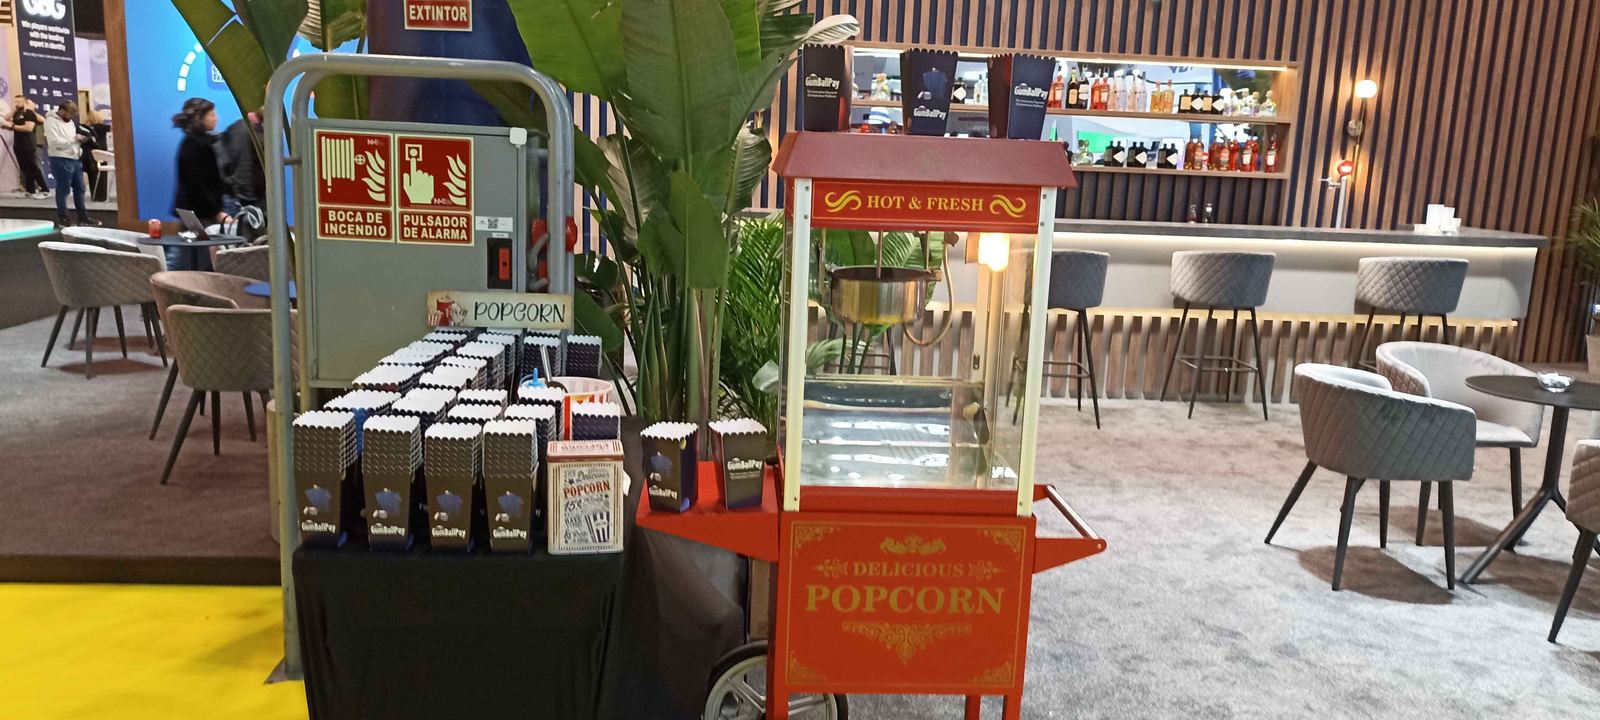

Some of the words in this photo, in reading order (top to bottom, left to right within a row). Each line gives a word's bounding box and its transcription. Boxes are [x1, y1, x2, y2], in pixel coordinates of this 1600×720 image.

[409, 4, 468, 22] EXTINTOR
[867, 195, 904, 210] HOT
[908, 196, 922, 210] &
[926, 197, 984, 212] FRESH
[328, 210, 363, 223] BOCA
[366, 211, 383, 224] DE
[403, 214, 468, 228] PULSADOR
[324, 223, 387, 237] INCENDIO
[403, 227, 419, 238] DE
[420, 228, 468, 240] ALARMA
[473, 301, 566, 323] POPCORN
[563, 480, 611, 499] POPCORN
[301, 522, 336, 534] GumBallPay
[370, 525, 406, 537] GumBallPay
[431, 527, 466, 539] GumBallPay
[493, 528, 527, 540] GumBallPay
[852, 560, 965, 578] DELICIOUS
[805, 584, 1006, 615] POPCORN
